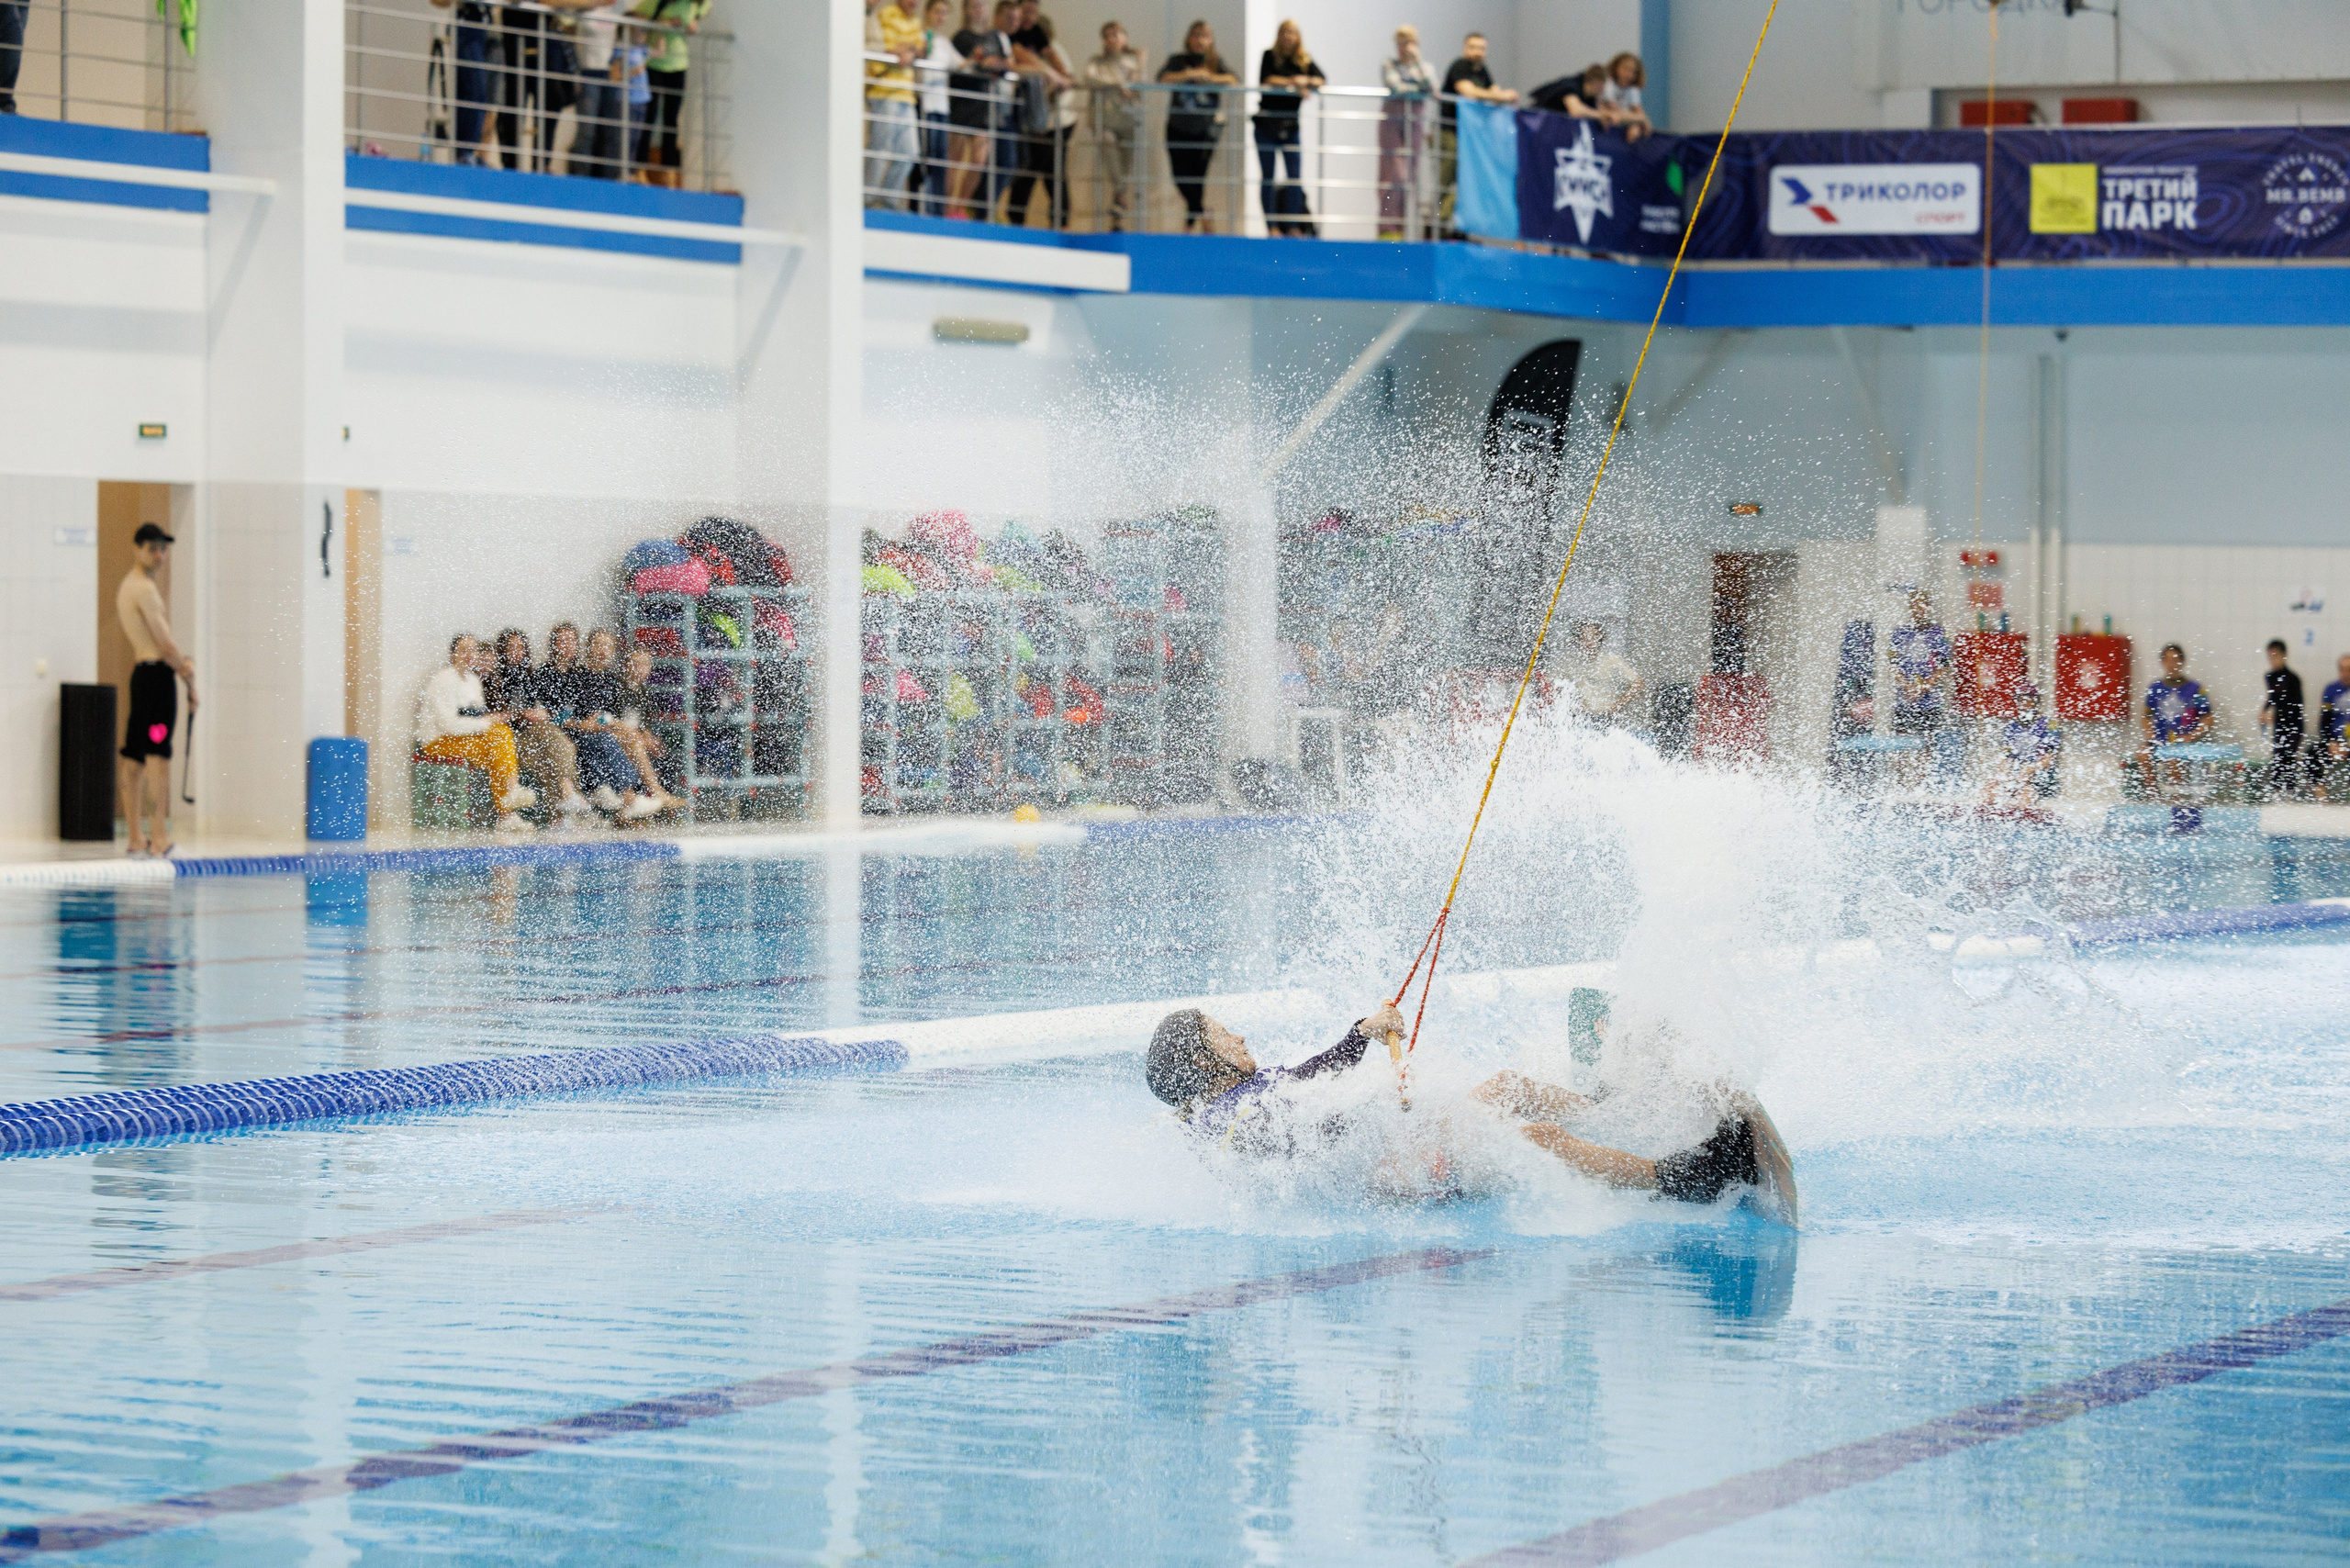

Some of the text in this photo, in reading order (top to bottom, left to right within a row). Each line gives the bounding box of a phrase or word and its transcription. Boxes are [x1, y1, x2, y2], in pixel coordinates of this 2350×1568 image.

[1825, 183, 1966, 201] ТРИКОЛОР
[2102, 174, 2198, 199] ТРЕТИЙ
[2103, 201, 2198, 230] ПАРК
